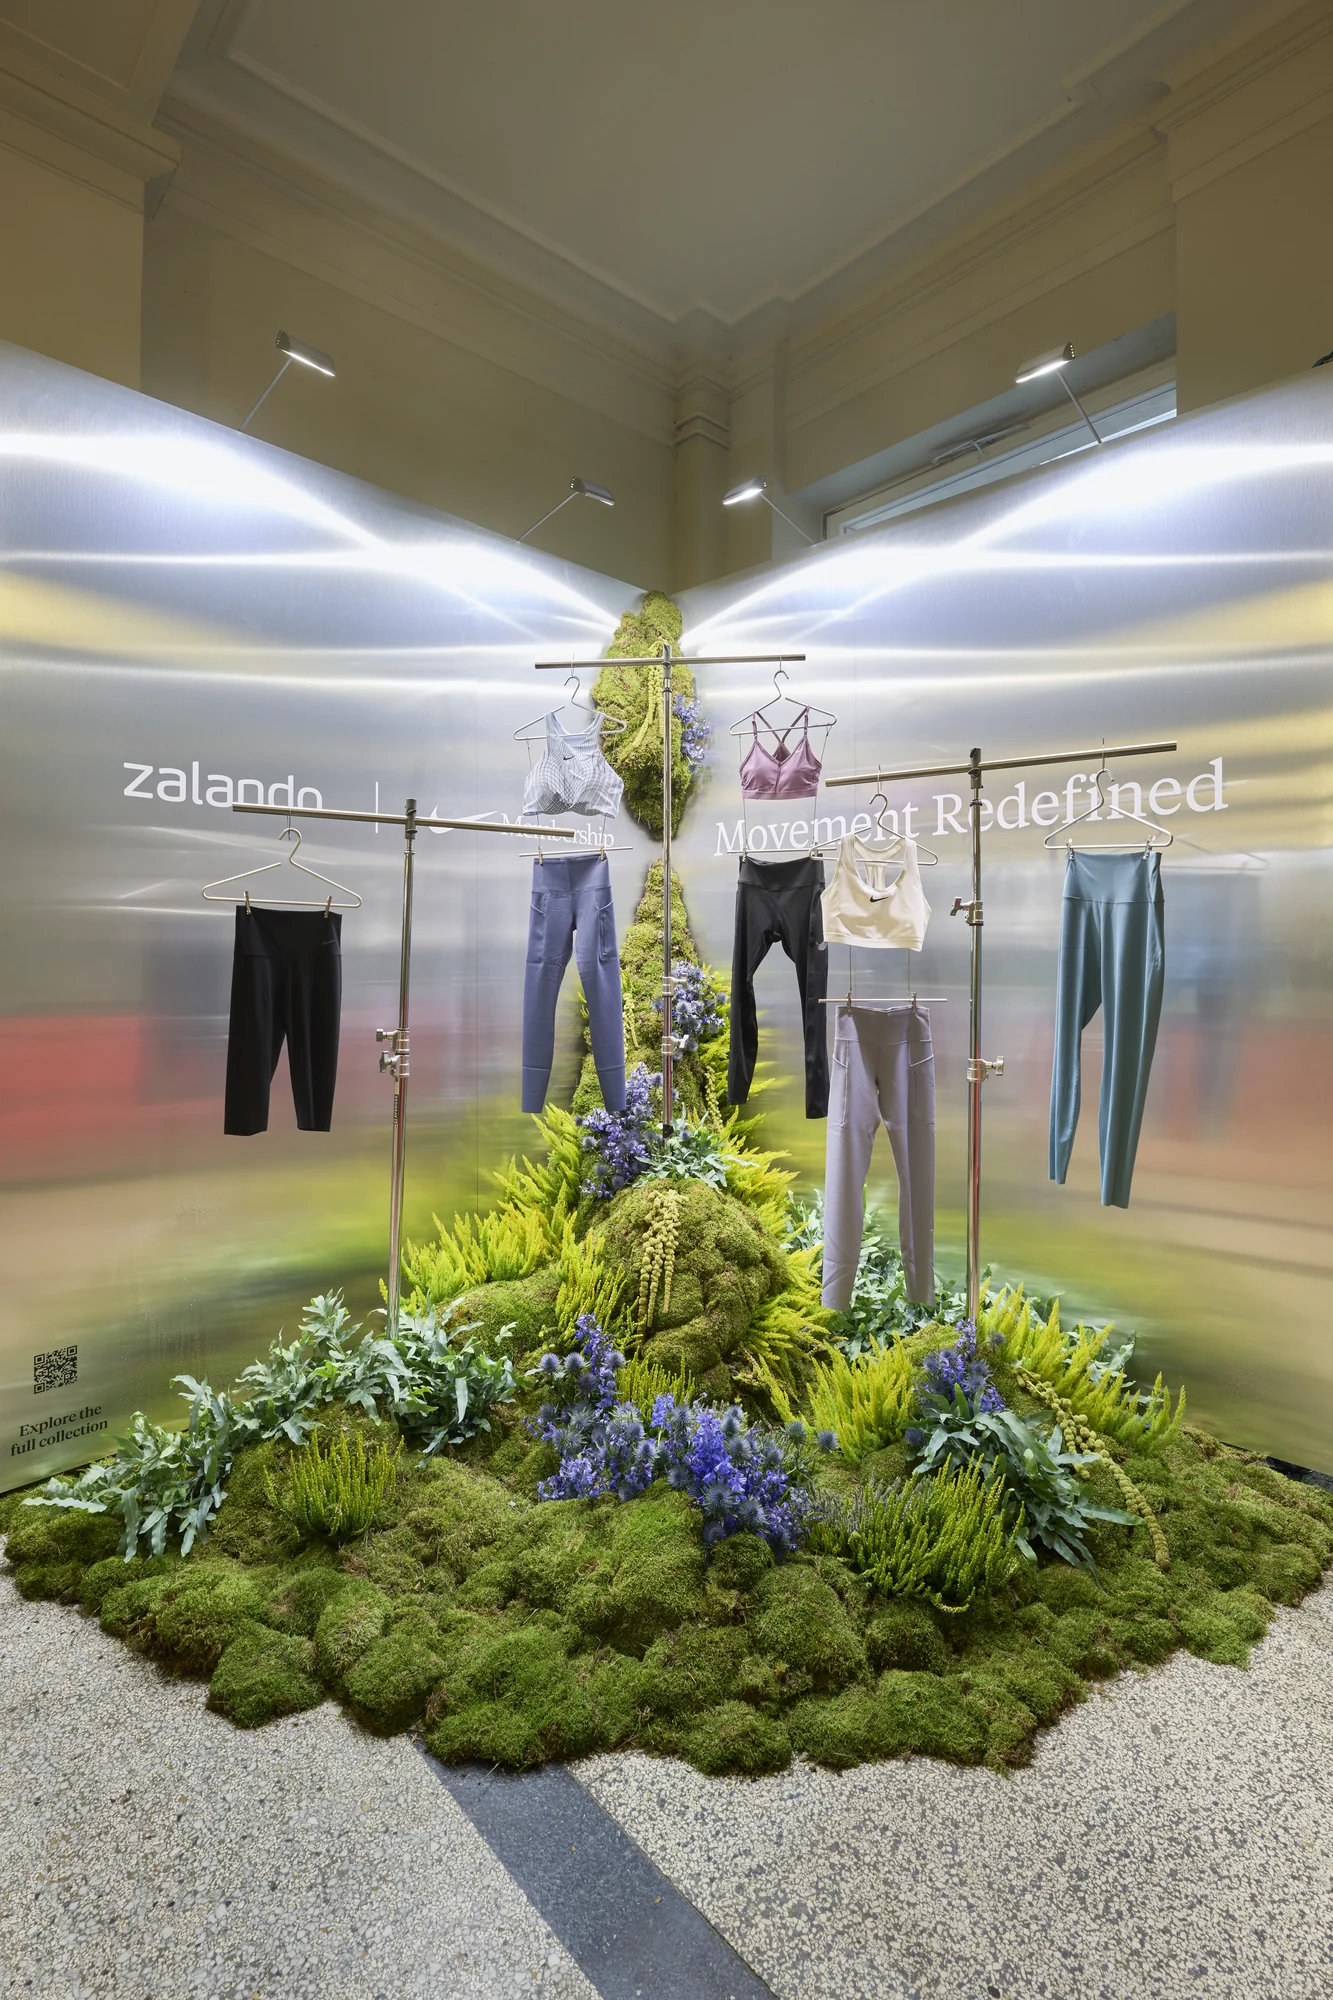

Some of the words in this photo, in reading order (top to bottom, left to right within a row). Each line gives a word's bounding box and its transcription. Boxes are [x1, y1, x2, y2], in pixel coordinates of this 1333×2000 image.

[123, 760, 323, 809] zalando
[714, 801, 920, 857] Movement
[932, 757, 1229, 836] Redefined
[10, 1437, 36, 1457] full
[39, 1420, 108, 1448] collection
[19, 1412, 77, 1438] Explore
[79, 1405, 102, 1420] the
